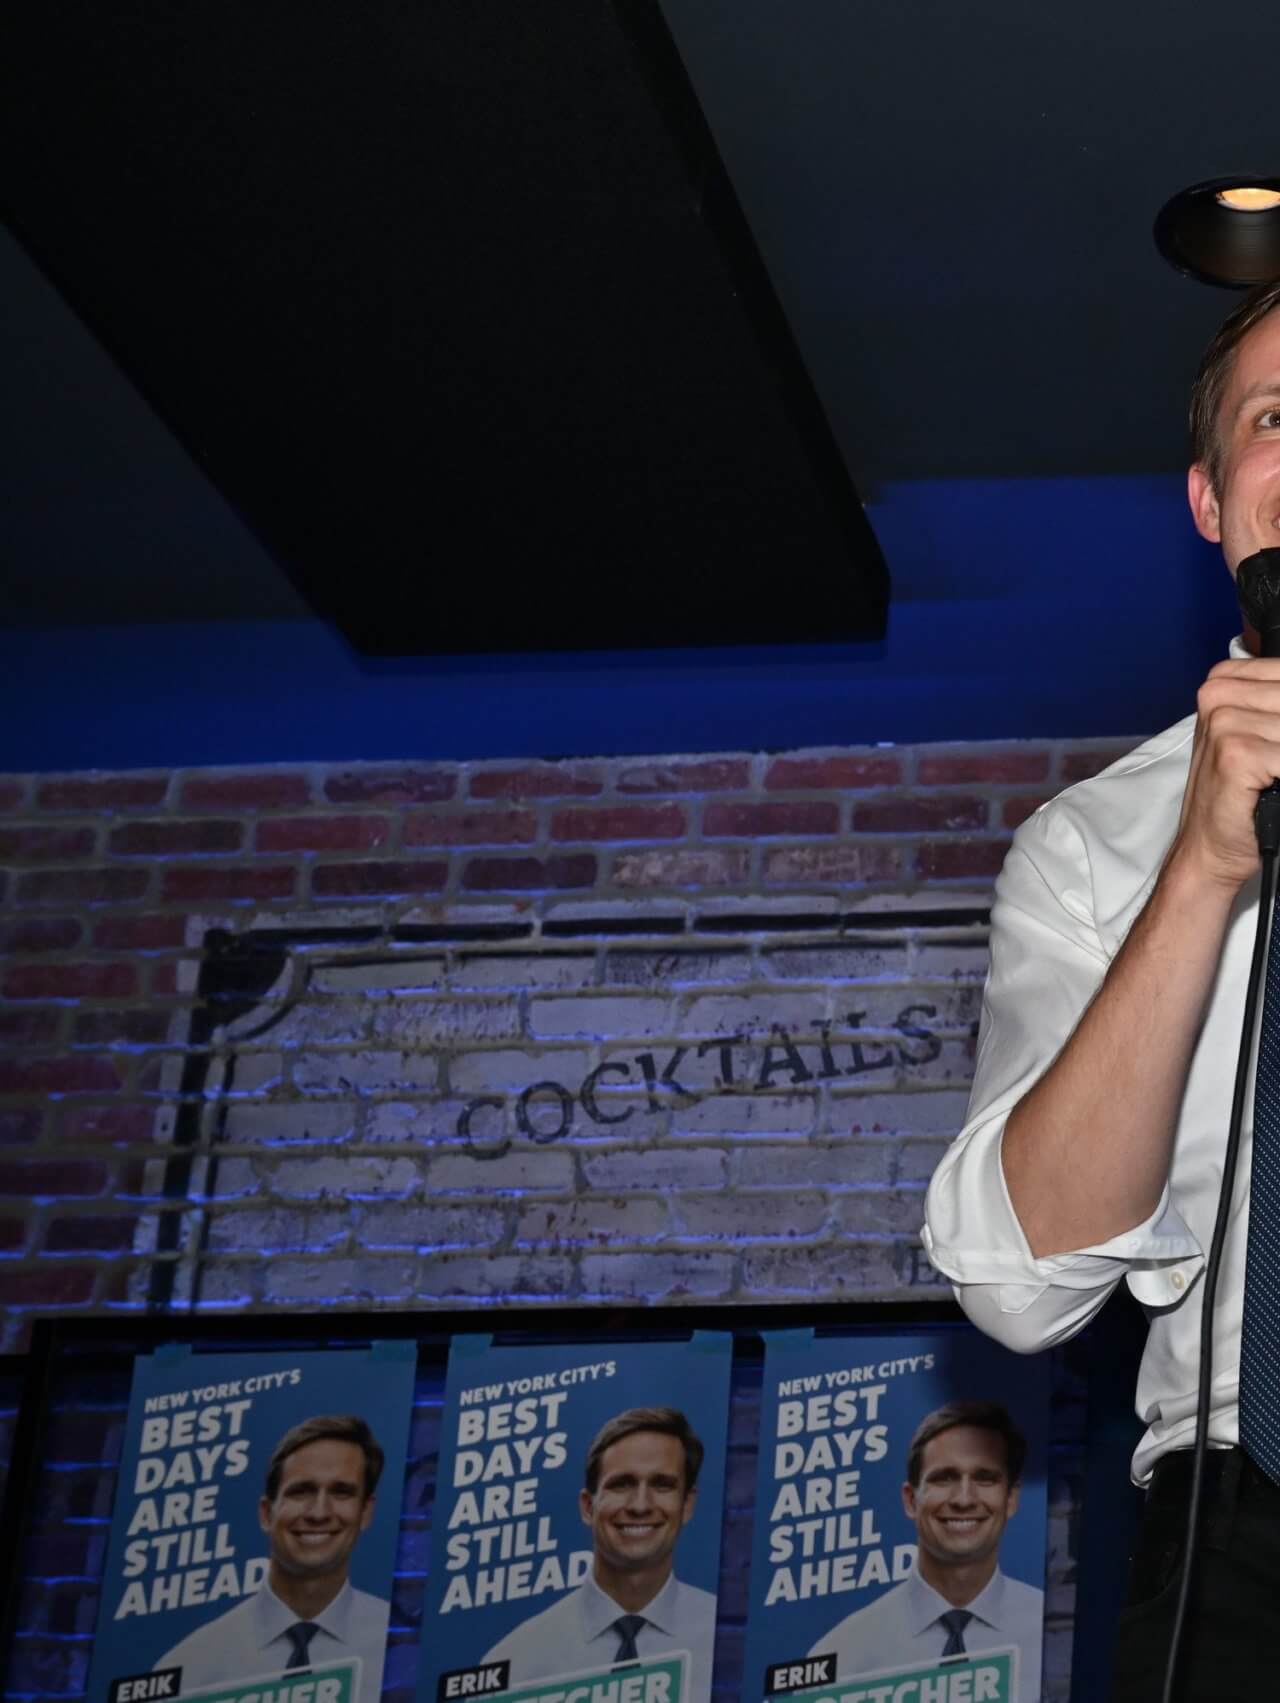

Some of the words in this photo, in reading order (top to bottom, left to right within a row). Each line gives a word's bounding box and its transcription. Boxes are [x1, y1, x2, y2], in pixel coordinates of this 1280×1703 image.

[456, 1004, 942, 1161] COCKTAILS
[144, 1392, 188, 1414] NEW
[192, 1380, 242, 1403] YORK
[244, 1368, 302, 1394] CITY'S
[459, 1384, 503, 1406] NEW
[506, 1373, 556, 1396] YORK
[559, 1360, 616, 1386] CITY'S
[778, 1374, 821, 1397] NEW
[824, 1364, 875, 1388] YORK
[878, 1354, 935, 1378] CITY'S
[140, 1399, 252, 1454] BEST
[457, 1392, 568, 1446] BEST
[776, 1384, 887, 1438] BEST
[134, 1440, 250, 1494] DAYS
[453, 1432, 568, 1488] DAYS
[774, 1425, 889, 1480] DAYS
[126, 1485, 220, 1536] ARE
[448, 1477, 538, 1530] ARE
[770, 1470, 860, 1522] ARE
[122, 1523, 236, 1578] STILL
[446, 1516, 558, 1571] STILL
[768, 1509, 881, 1564] STILL
[113, 1556, 272, 1621] AHEAD
[438, 1550, 594, 1614] AHEAD
[764, 1544, 919, 1606] AHEAD
[116, 1674, 175, 1702] ERIK
[446, 1667, 503, 1698] ERIK
[773, 1660, 830, 1690] ERIK
